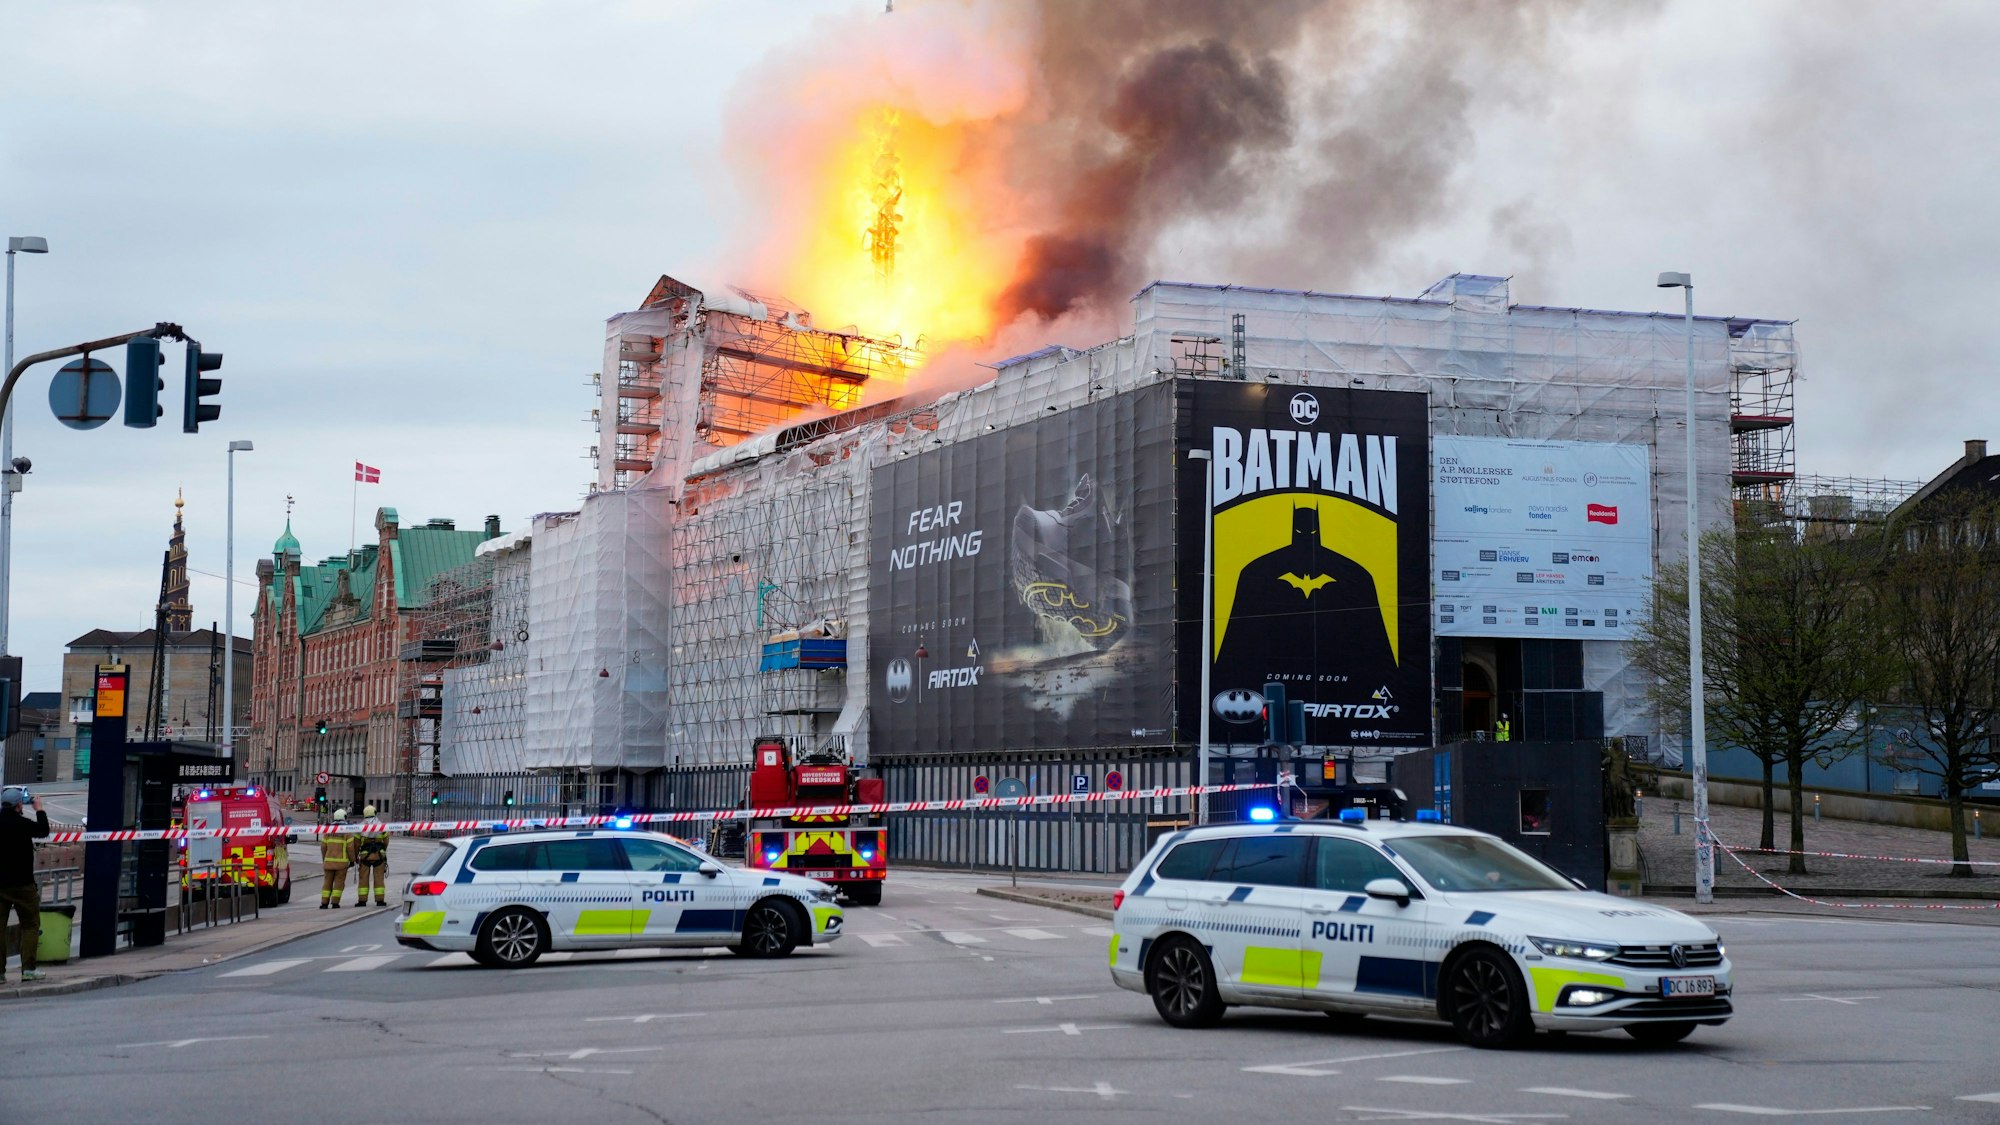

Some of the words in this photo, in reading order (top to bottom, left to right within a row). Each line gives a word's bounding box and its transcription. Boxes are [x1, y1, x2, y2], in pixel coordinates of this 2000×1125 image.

[1291, 398, 1318, 419] DC
[1439, 457, 1458, 465] DEN
[1212, 426, 1399, 516] BATMAN
[1440, 466, 1456, 474] A.P.
[1458, 466, 1513, 476] MØLLERSKE
[1439, 475, 1500, 486] STØTTEFOND
[1464, 505, 1488, 514] salling
[907, 500, 963, 535] FEAR
[889, 530, 982, 572] NOTHING
[1571, 555, 1600, 563] emcon
[902, 621, 935, 634] COMING
[942, 617, 967, 628] SOON
[1266, 673, 1312, 682] COMING
[1318, 674, 1349, 683] SOON
[1076, 777, 1086, 789] P
[642, 889, 695, 903] POLITI
[1312, 921, 1374, 943] POLITI
[1669, 980, 1683, 993] DC
[1685, 980, 1695, 993] 16
[1696, 980, 1713, 993] 893
